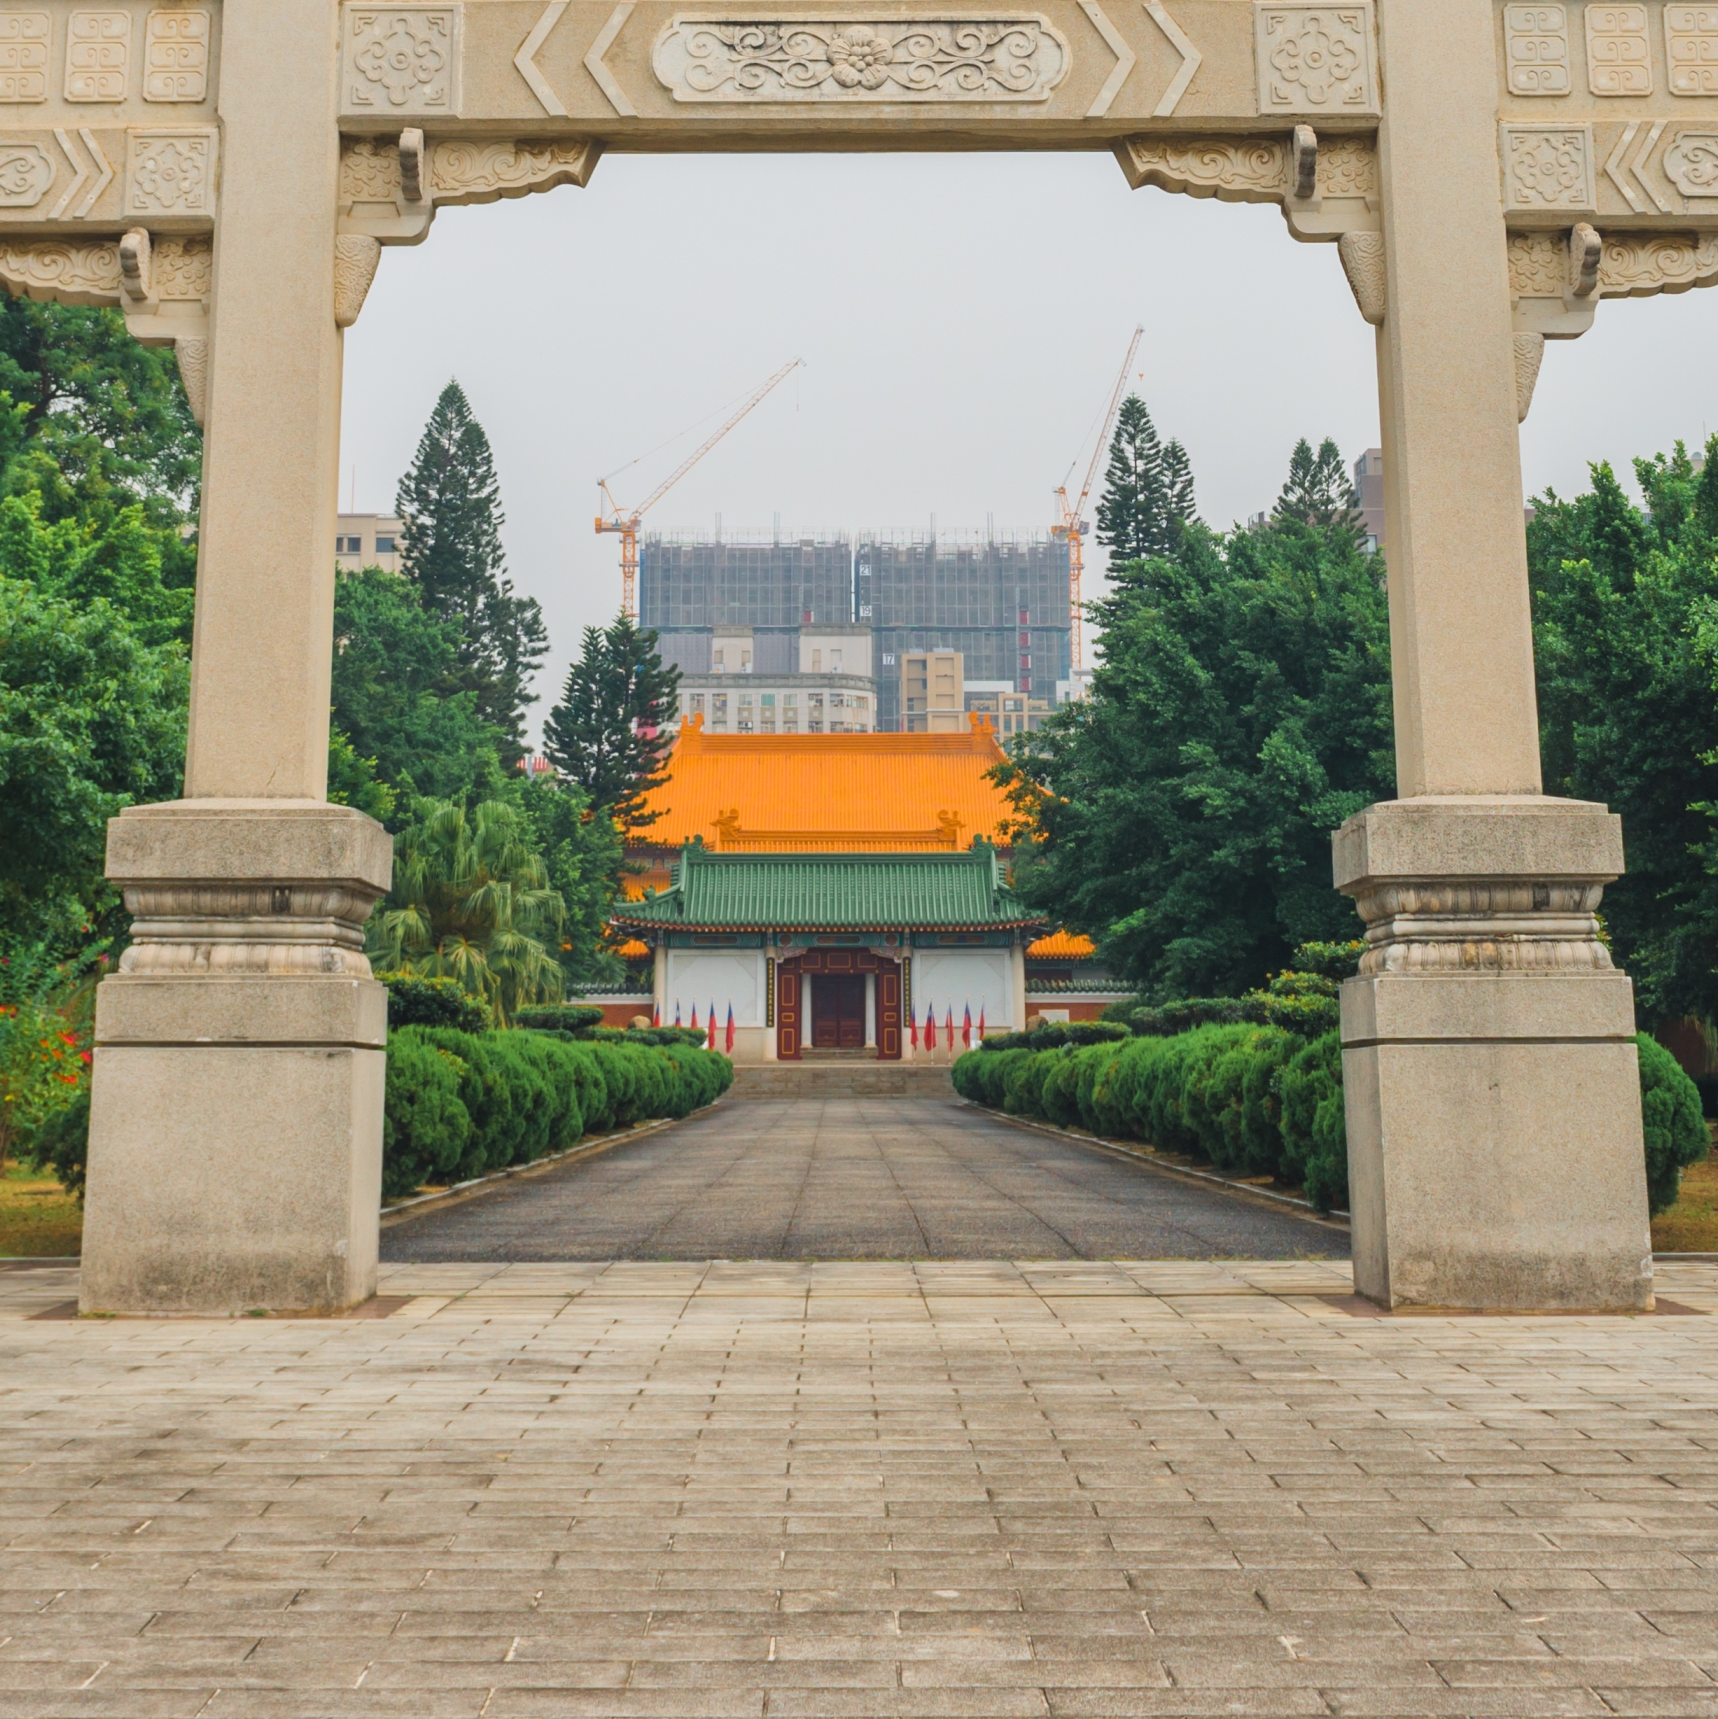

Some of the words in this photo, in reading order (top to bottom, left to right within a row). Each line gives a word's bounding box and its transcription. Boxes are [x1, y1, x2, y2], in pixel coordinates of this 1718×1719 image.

[861, 565, 871, 575] 21
[860, 606, 871, 616] 19
[884, 654, 894, 664] 17
